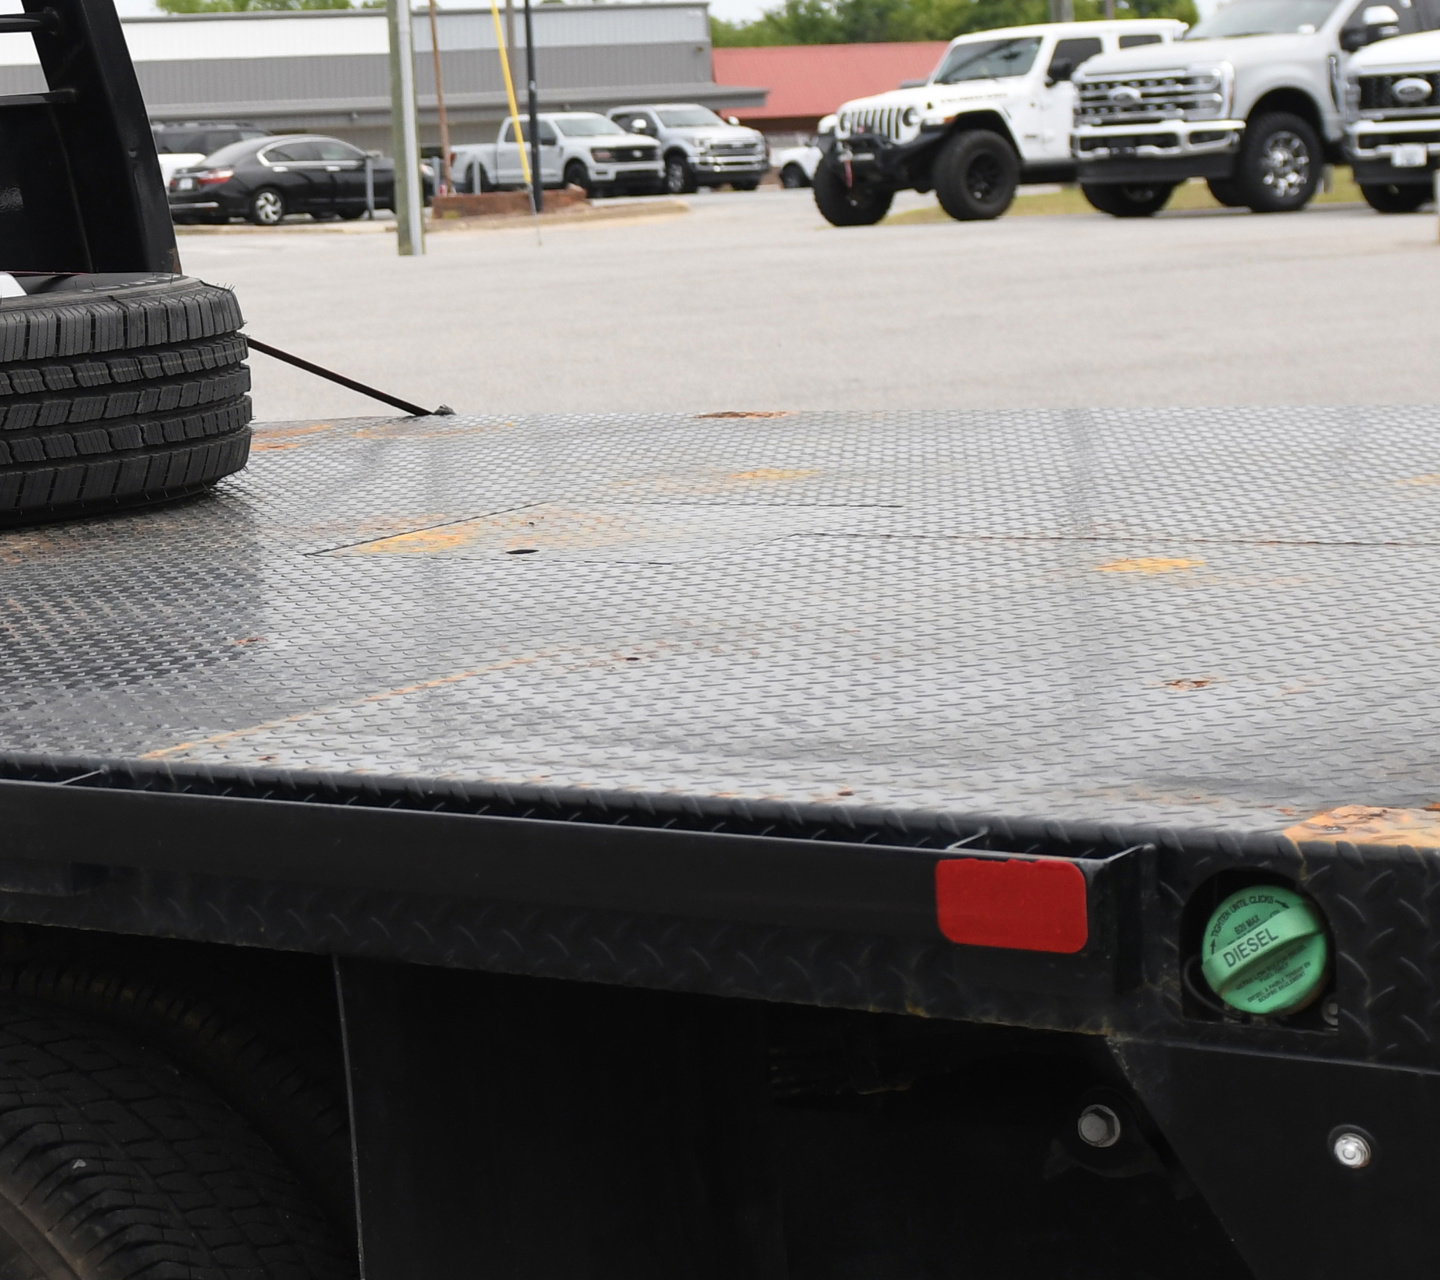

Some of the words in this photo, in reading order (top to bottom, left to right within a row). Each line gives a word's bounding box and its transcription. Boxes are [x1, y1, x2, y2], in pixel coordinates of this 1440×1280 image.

[1211, 910, 1232, 937] TIGHTEN
[1229, 899, 1249, 913] UNTIL
[1223, 928, 1279, 968] DIESEL
